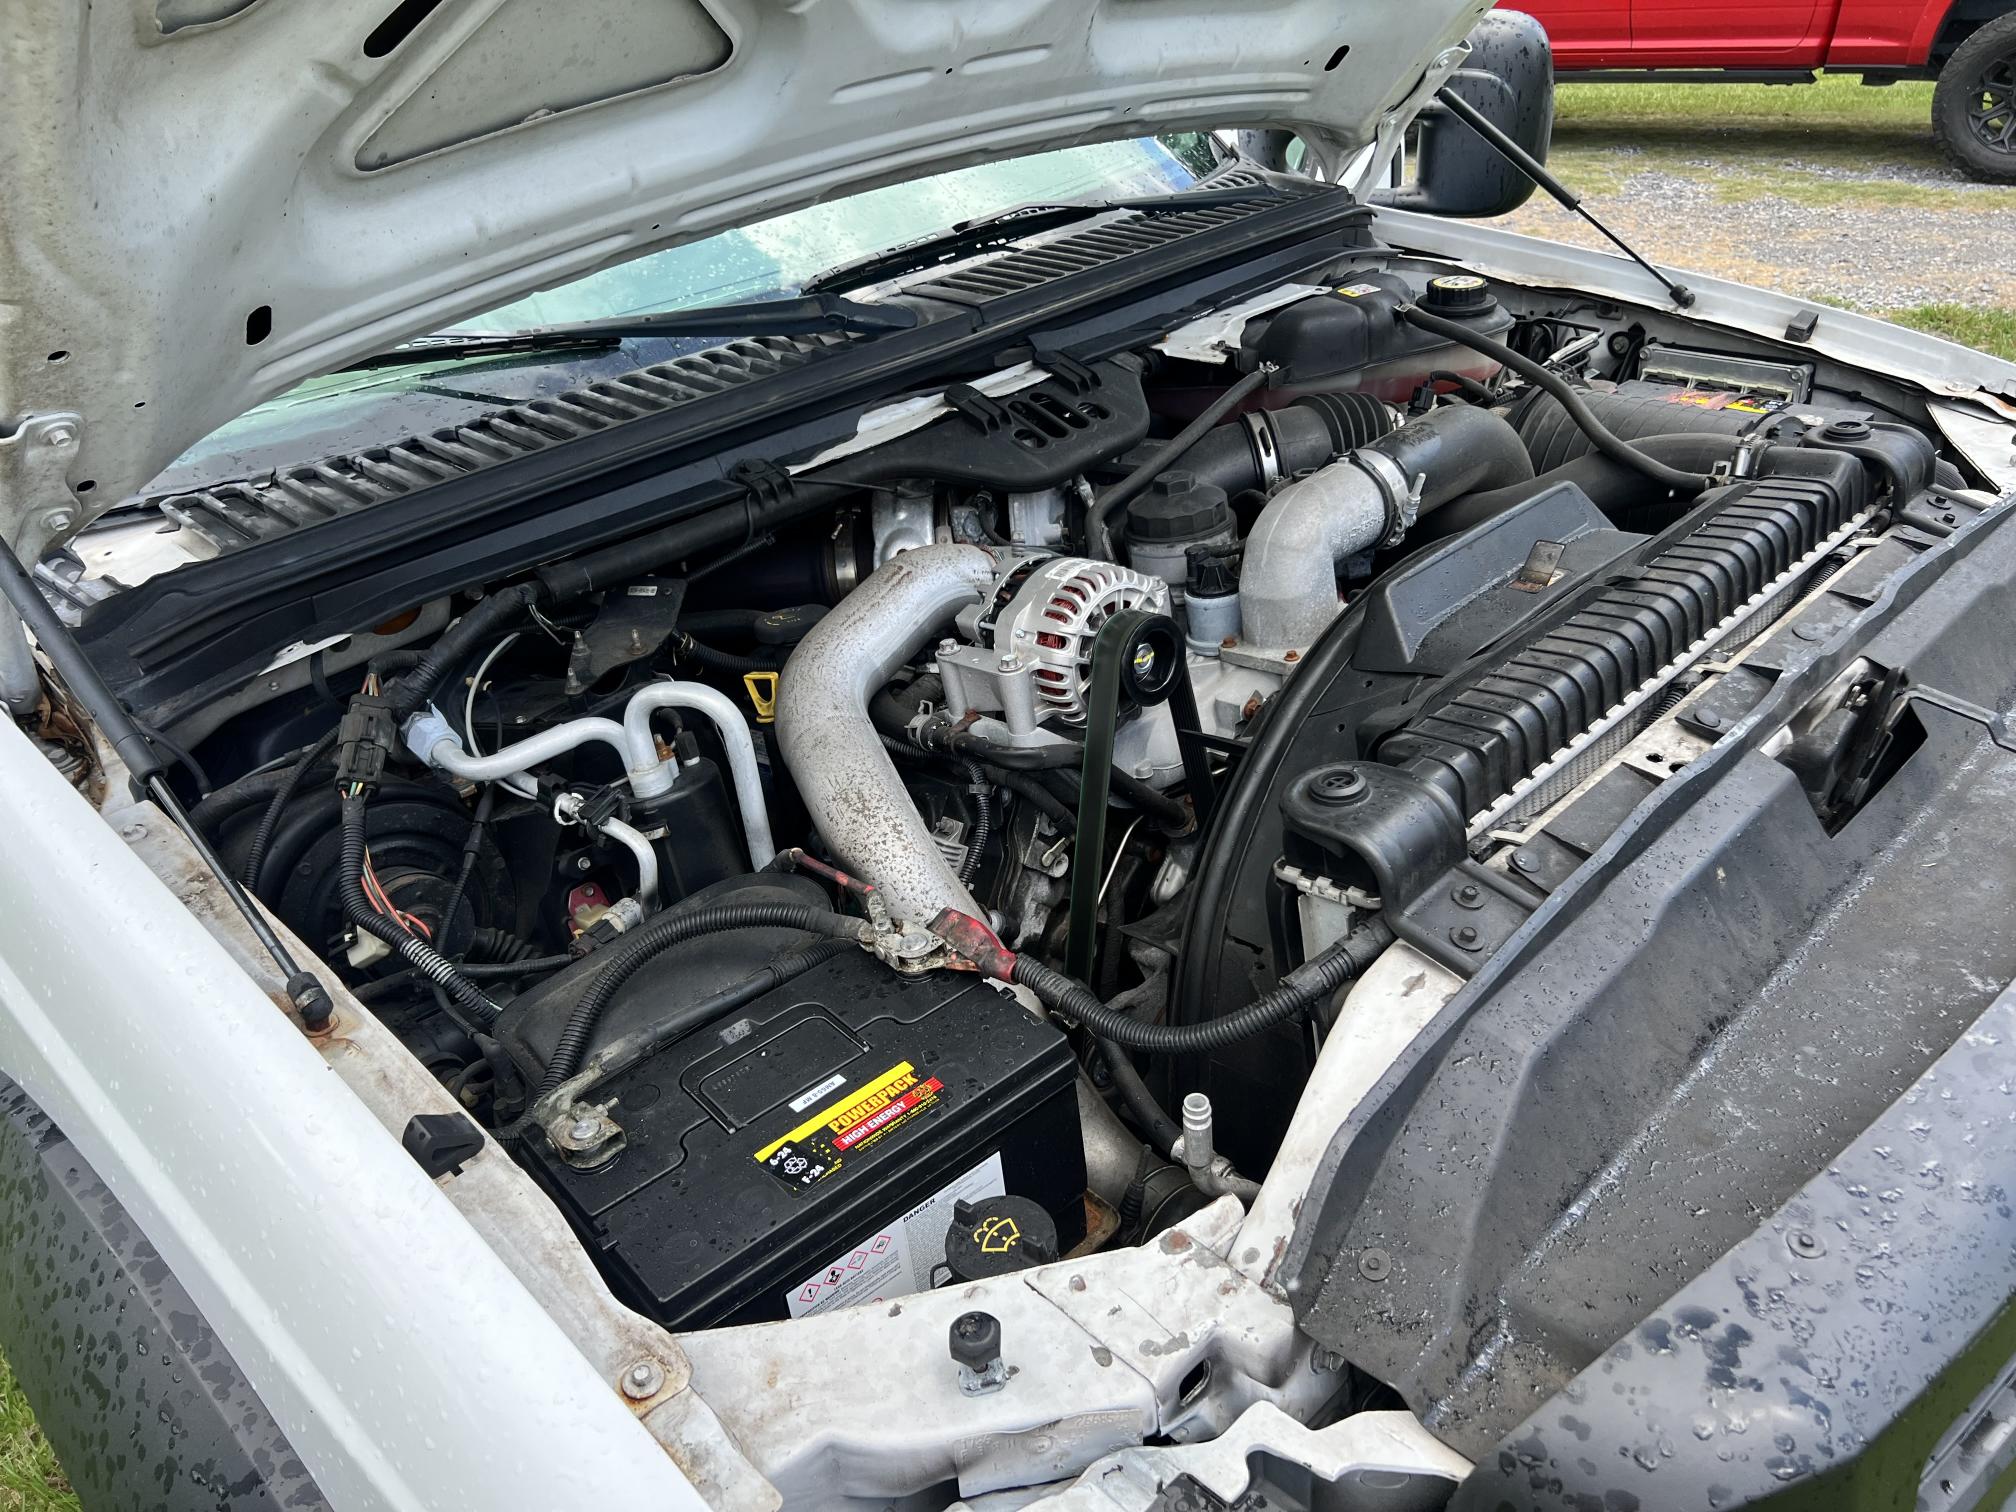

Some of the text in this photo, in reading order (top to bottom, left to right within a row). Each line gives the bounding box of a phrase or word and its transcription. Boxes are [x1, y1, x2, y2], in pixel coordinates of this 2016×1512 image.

[828, 1072, 919, 1133] POWERPACK
[841, 1124, 870, 1145] HIGH
[868, 1100, 907, 1129] ENERGY
[769, 1146, 793, 1166] 6-24
[801, 1164, 825, 1184] F-24
[903, 1197, 936, 1223] DANGER
